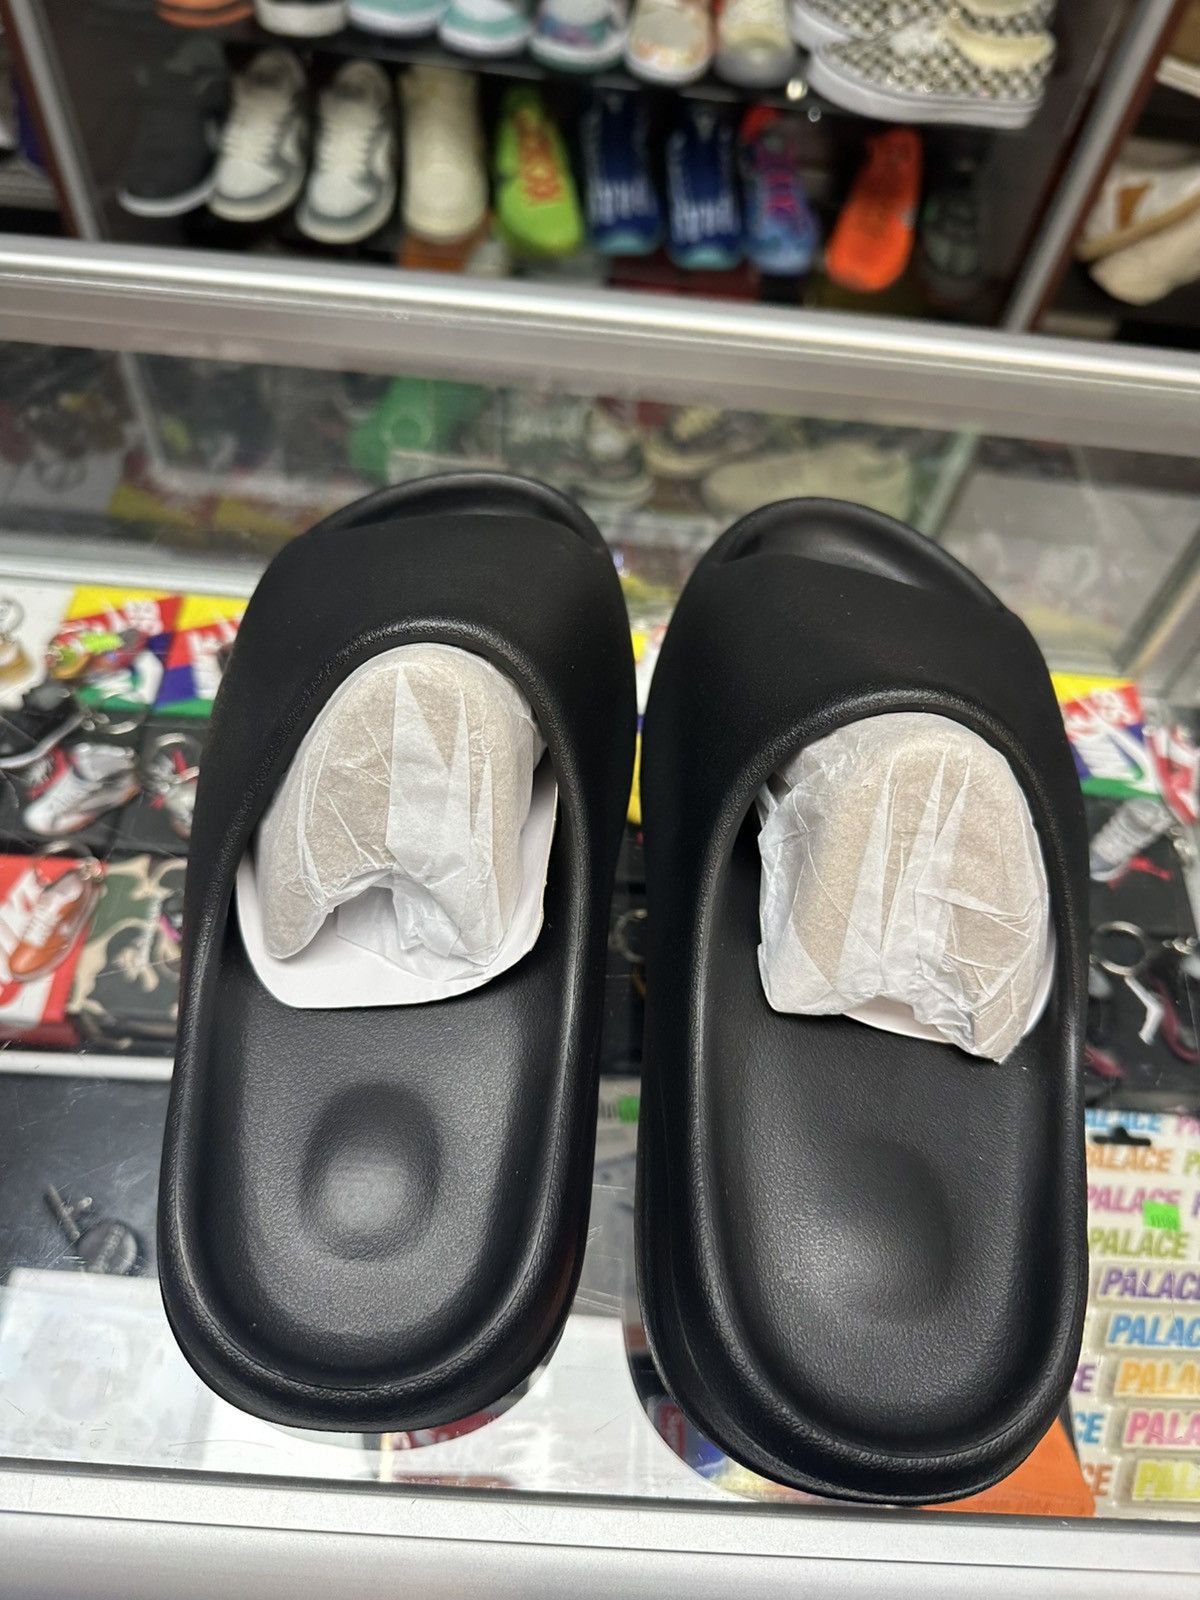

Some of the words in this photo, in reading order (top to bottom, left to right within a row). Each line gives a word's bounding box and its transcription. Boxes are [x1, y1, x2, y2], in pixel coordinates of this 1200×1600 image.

[1085, 1109, 1163, 1133] ALACE
[1086, 1146, 1173, 1173] ALACE
[1089, 1227, 1189, 1259] PALACE
[1101, 1266, 1200, 1300] PALAC
